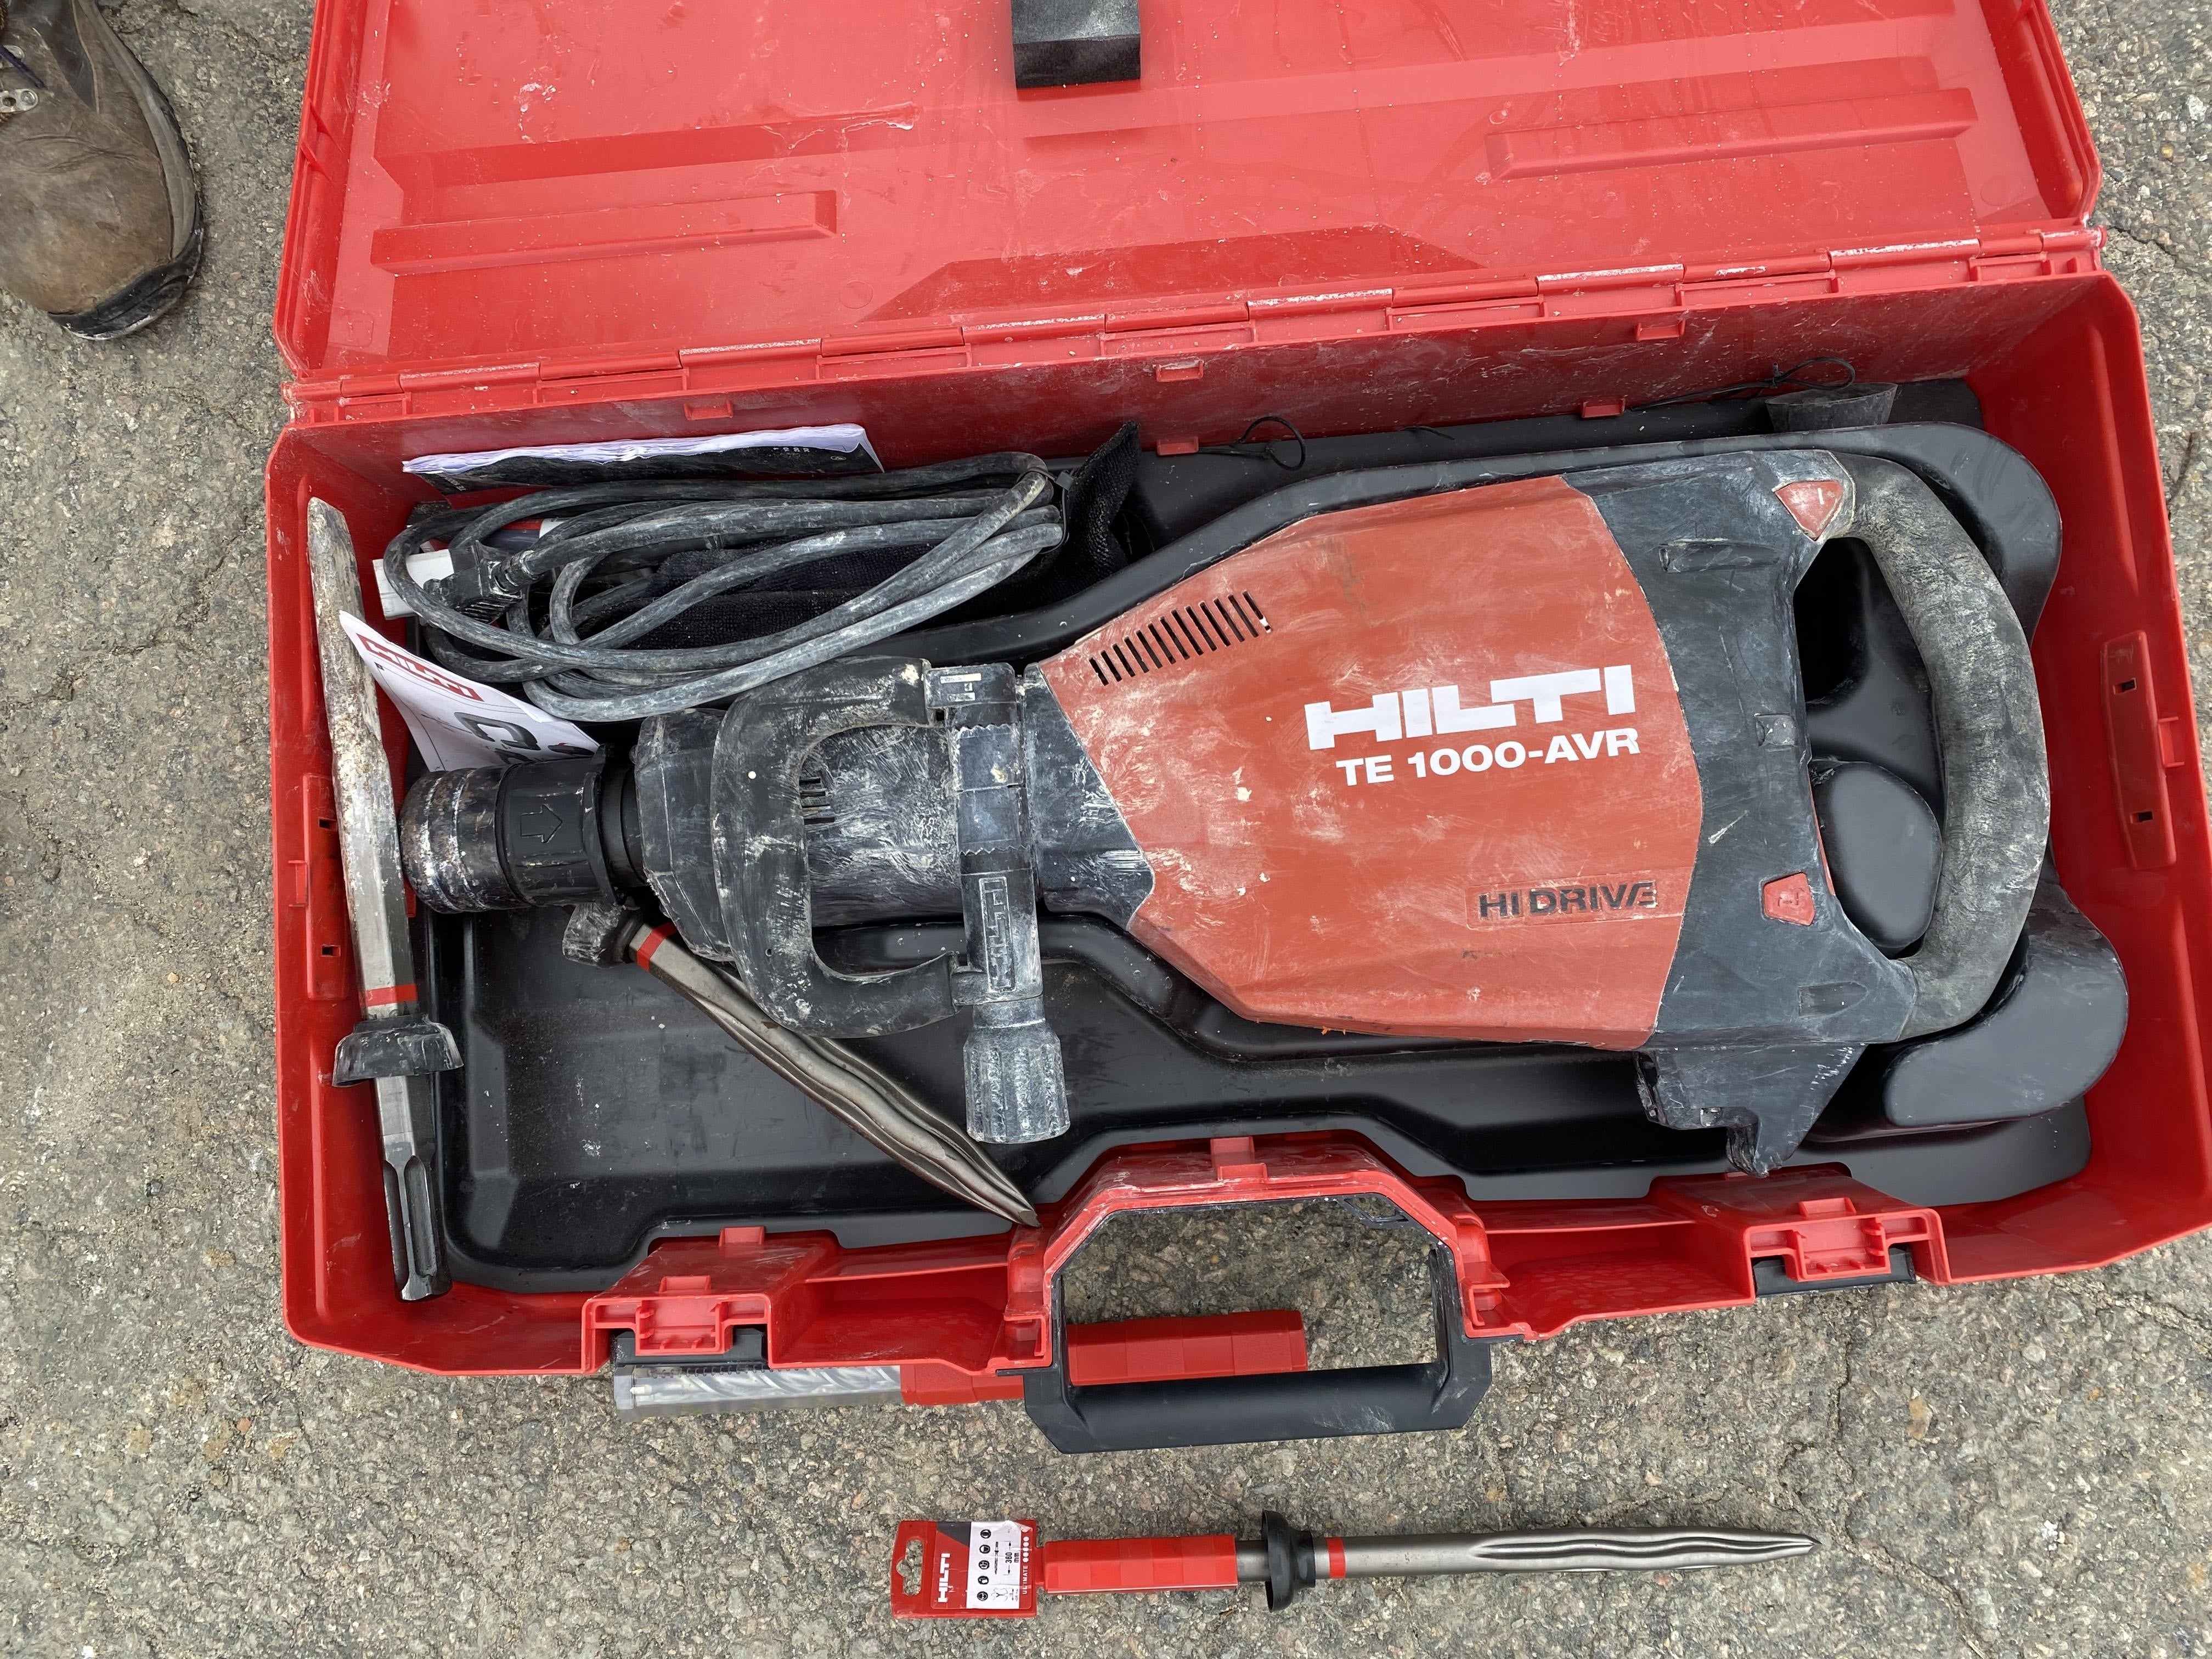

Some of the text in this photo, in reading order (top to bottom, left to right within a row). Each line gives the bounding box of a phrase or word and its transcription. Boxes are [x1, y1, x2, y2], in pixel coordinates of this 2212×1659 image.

[365, 640, 473, 697] HILTI
[1305, 664, 1636, 751] HILTI
[1336, 727, 1640, 786] TE 1000-AVR
[1478, 880, 1659, 920] HI DRIVE
[938, 1553, 951, 1603] HILTI
[1014, 1553, 1019, 1563] mm
